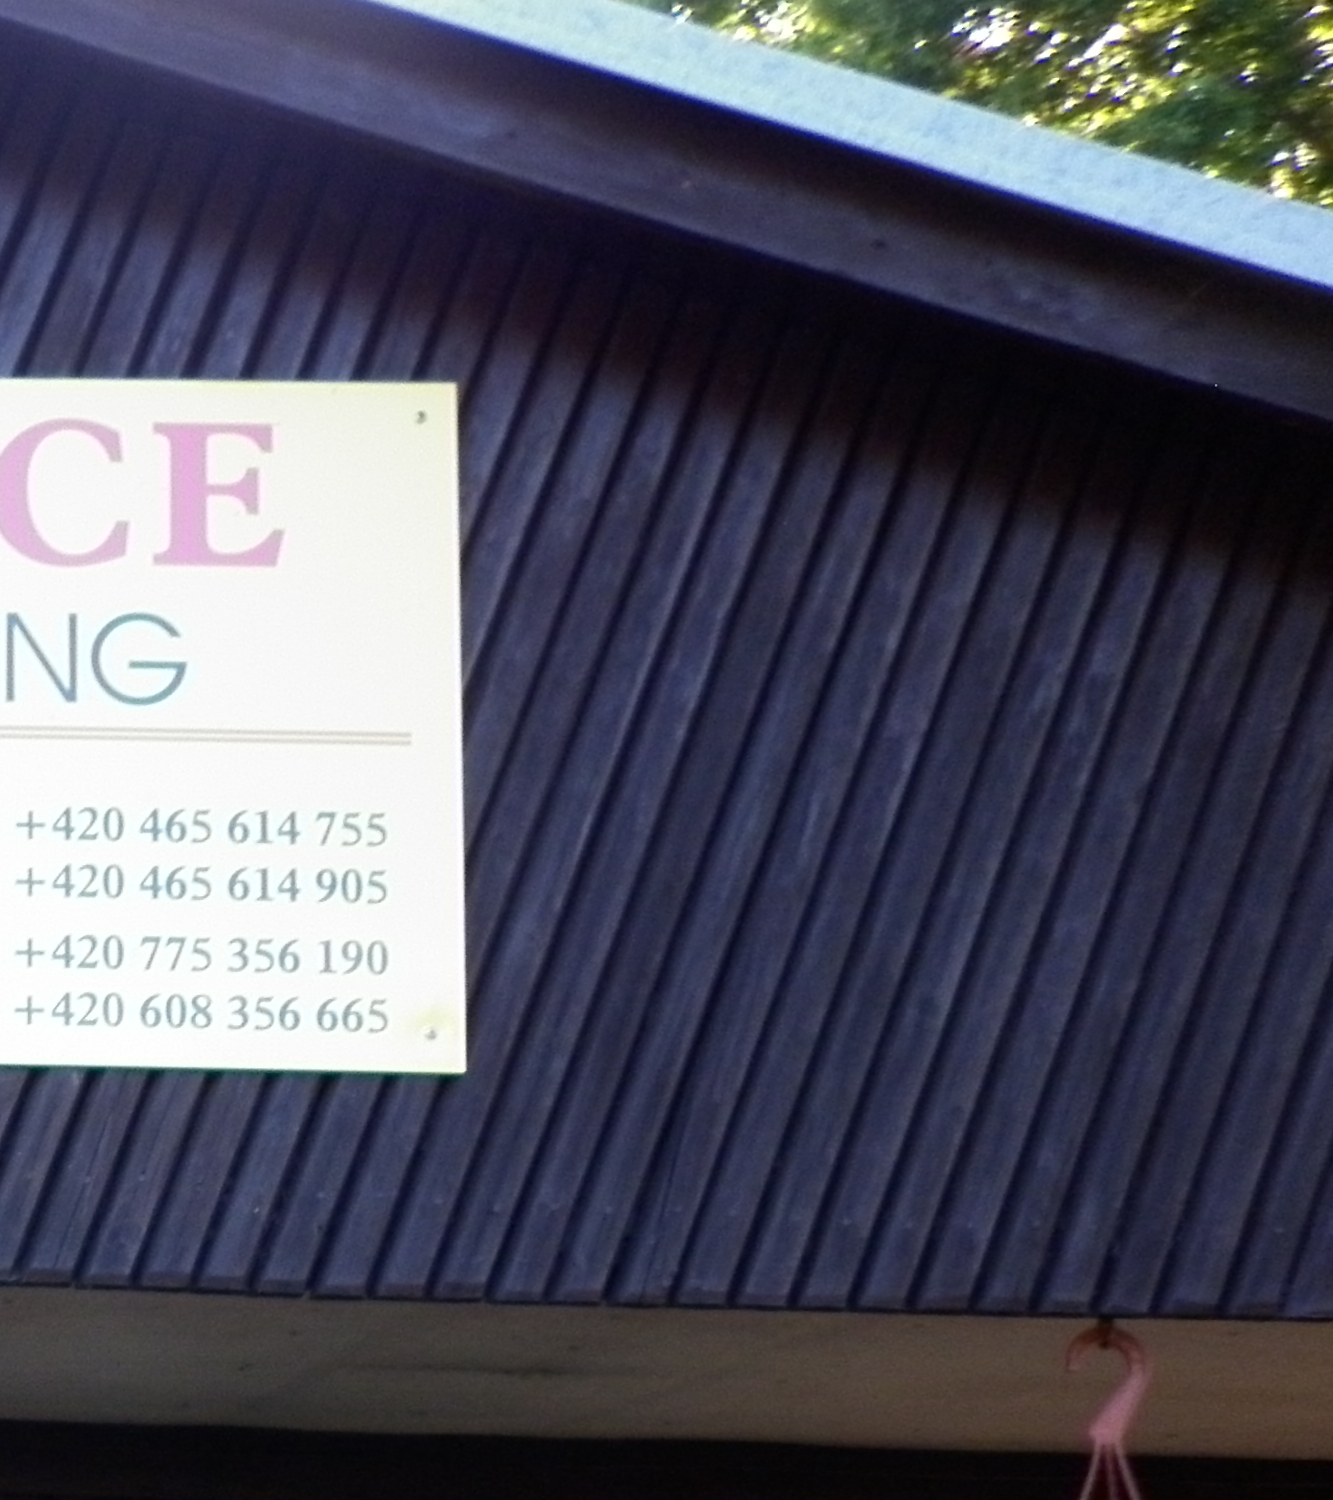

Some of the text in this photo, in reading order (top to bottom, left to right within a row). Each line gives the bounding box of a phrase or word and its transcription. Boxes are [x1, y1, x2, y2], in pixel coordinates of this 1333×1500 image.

[14, 806, 125, 843] +420
[139, 807, 213, 845] 465
[227, 809, 301, 847] 614
[315, 810, 389, 848] 755
[14, 863, 389, 905] +420 465 614 905
[14, 933, 125, 971] +420
[139, 935, 213, 974] 775
[227, 937, 301, 975] 356
[318, 938, 389, 976] 190
[14, 991, 389, 1035] +420 608 356 665
